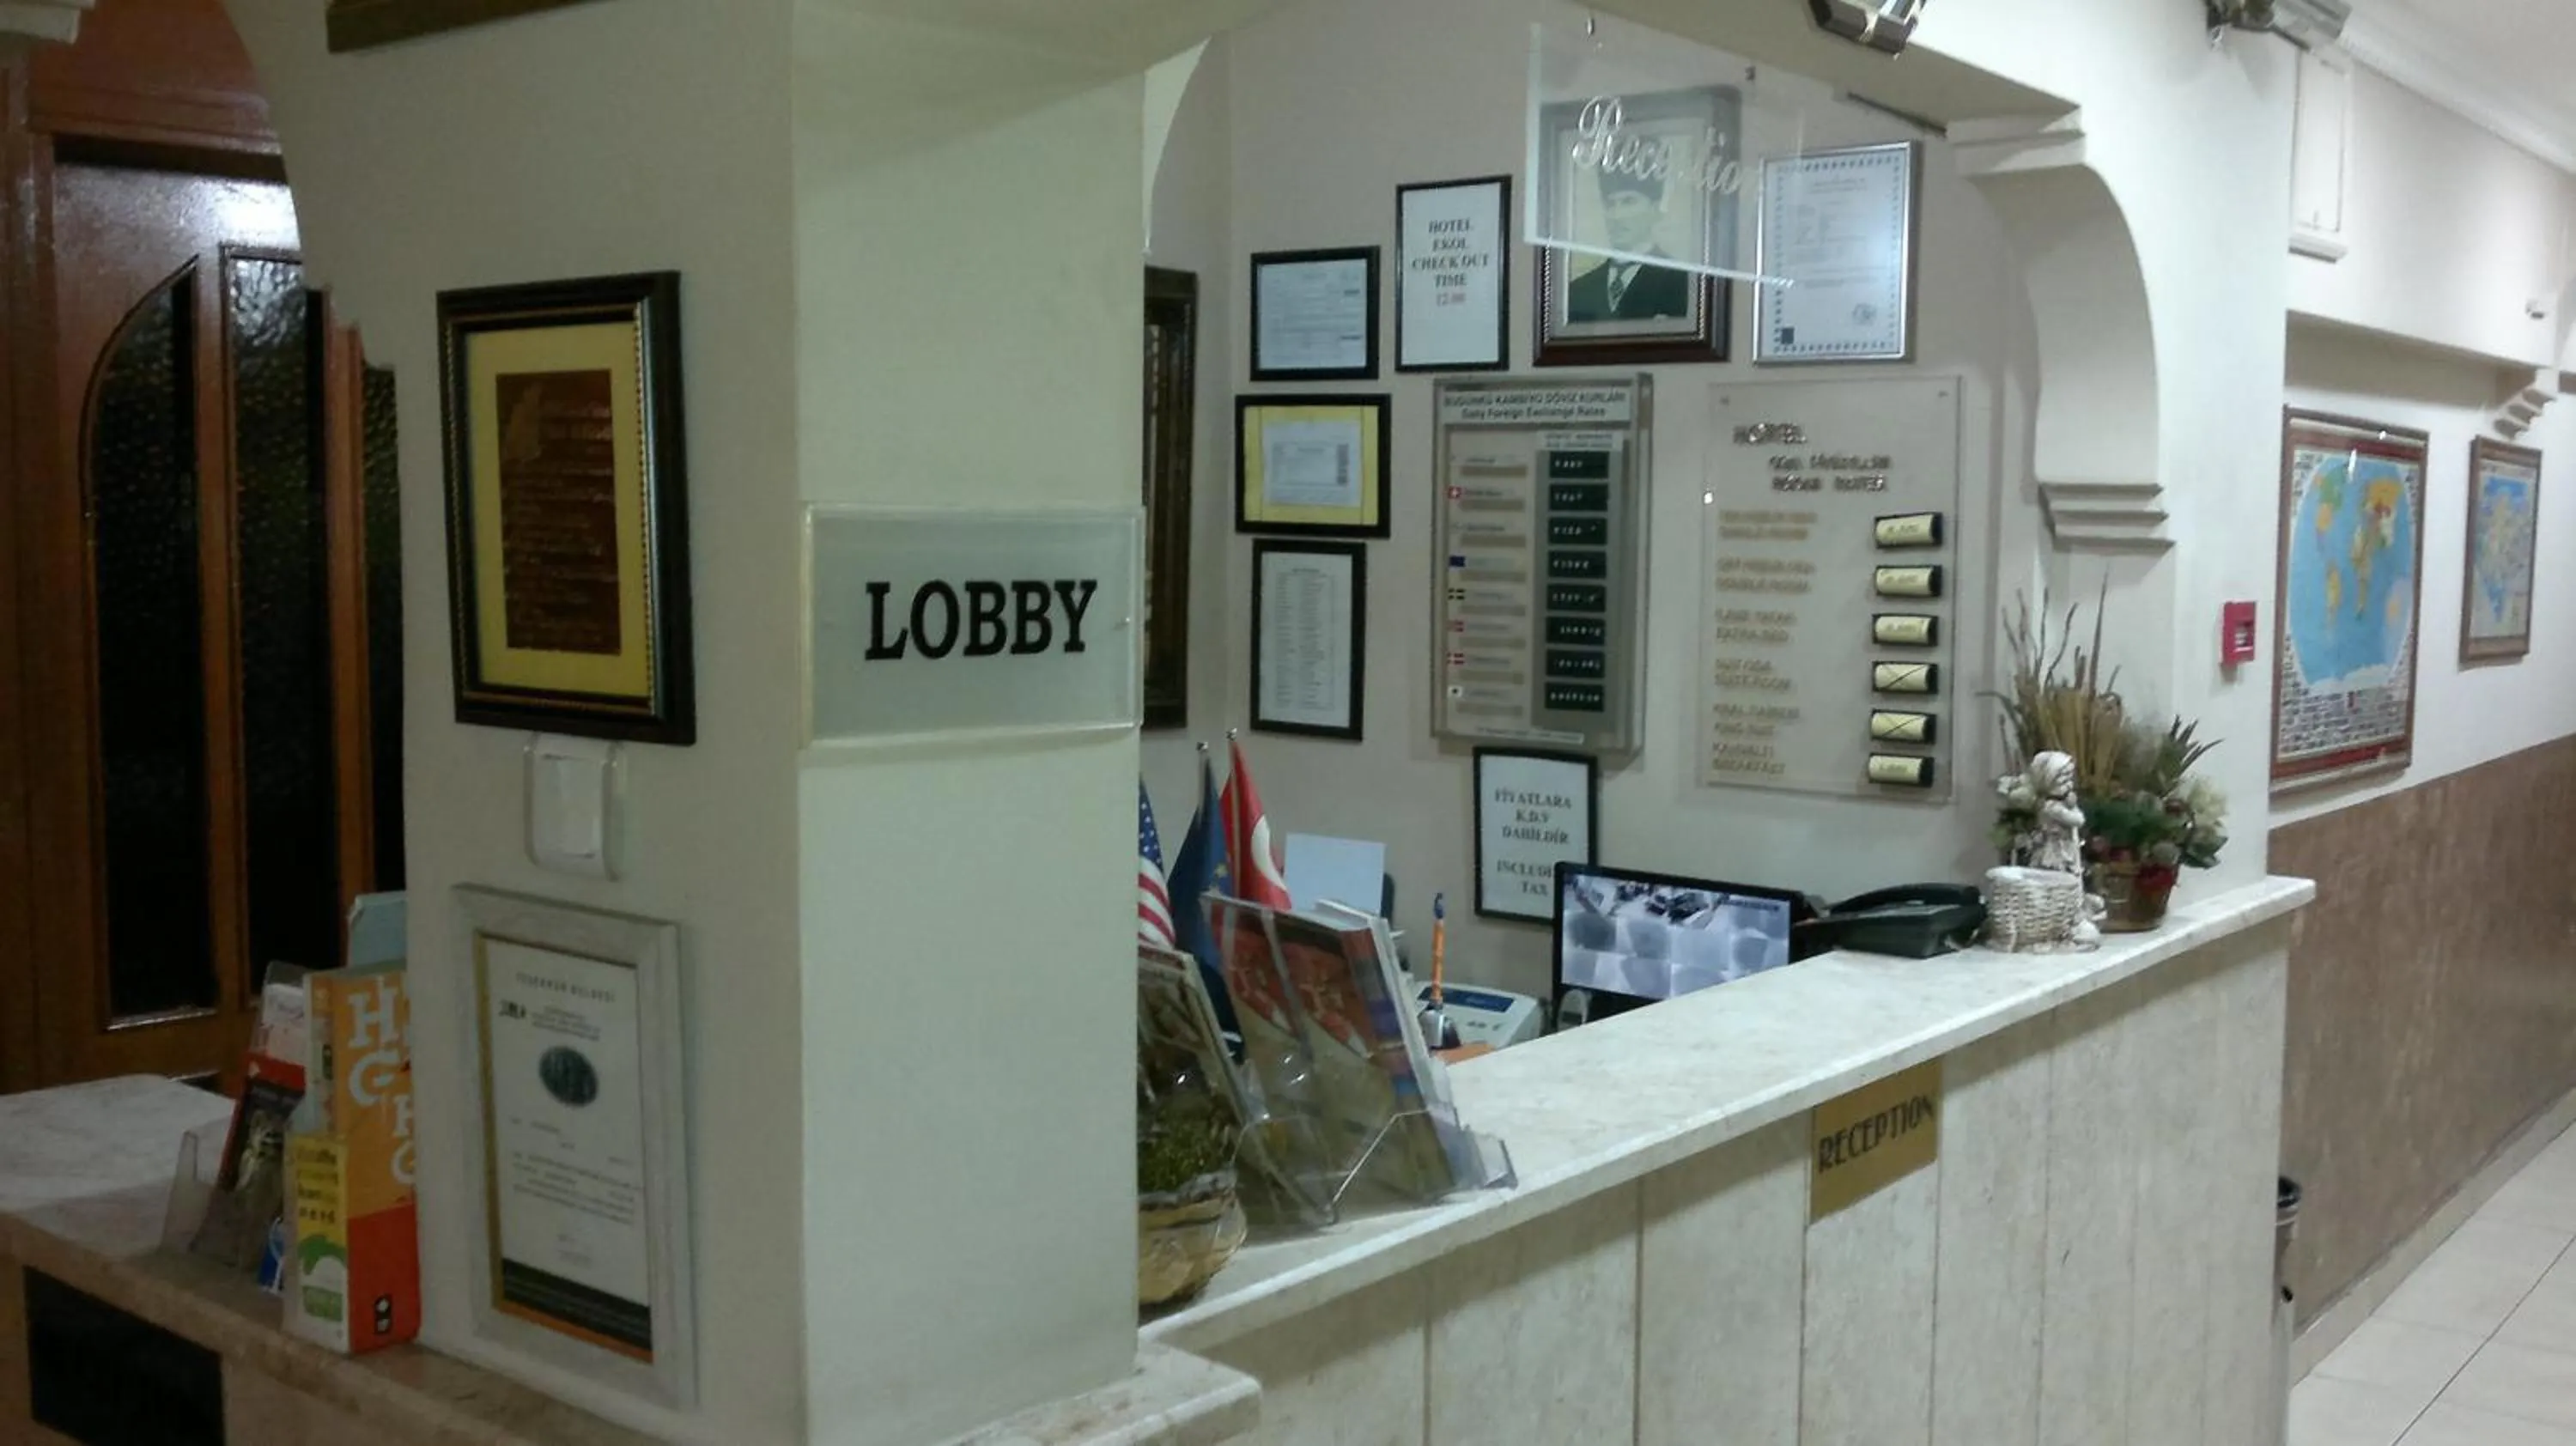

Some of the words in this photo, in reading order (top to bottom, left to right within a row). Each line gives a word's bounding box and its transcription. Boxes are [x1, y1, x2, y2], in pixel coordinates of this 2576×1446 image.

[1429, 217, 1473, 233] HOTEL
[1413, 256, 1459, 270] CHECK
[1461, 253, 1489, 268] OUT
[1434, 273, 1467, 288] TIME
[865, 579, 1097, 660] LOBBY
[1522, 881, 1548, 896] TAX
[1818, 1095, 1933, 1175] RECEPTION
